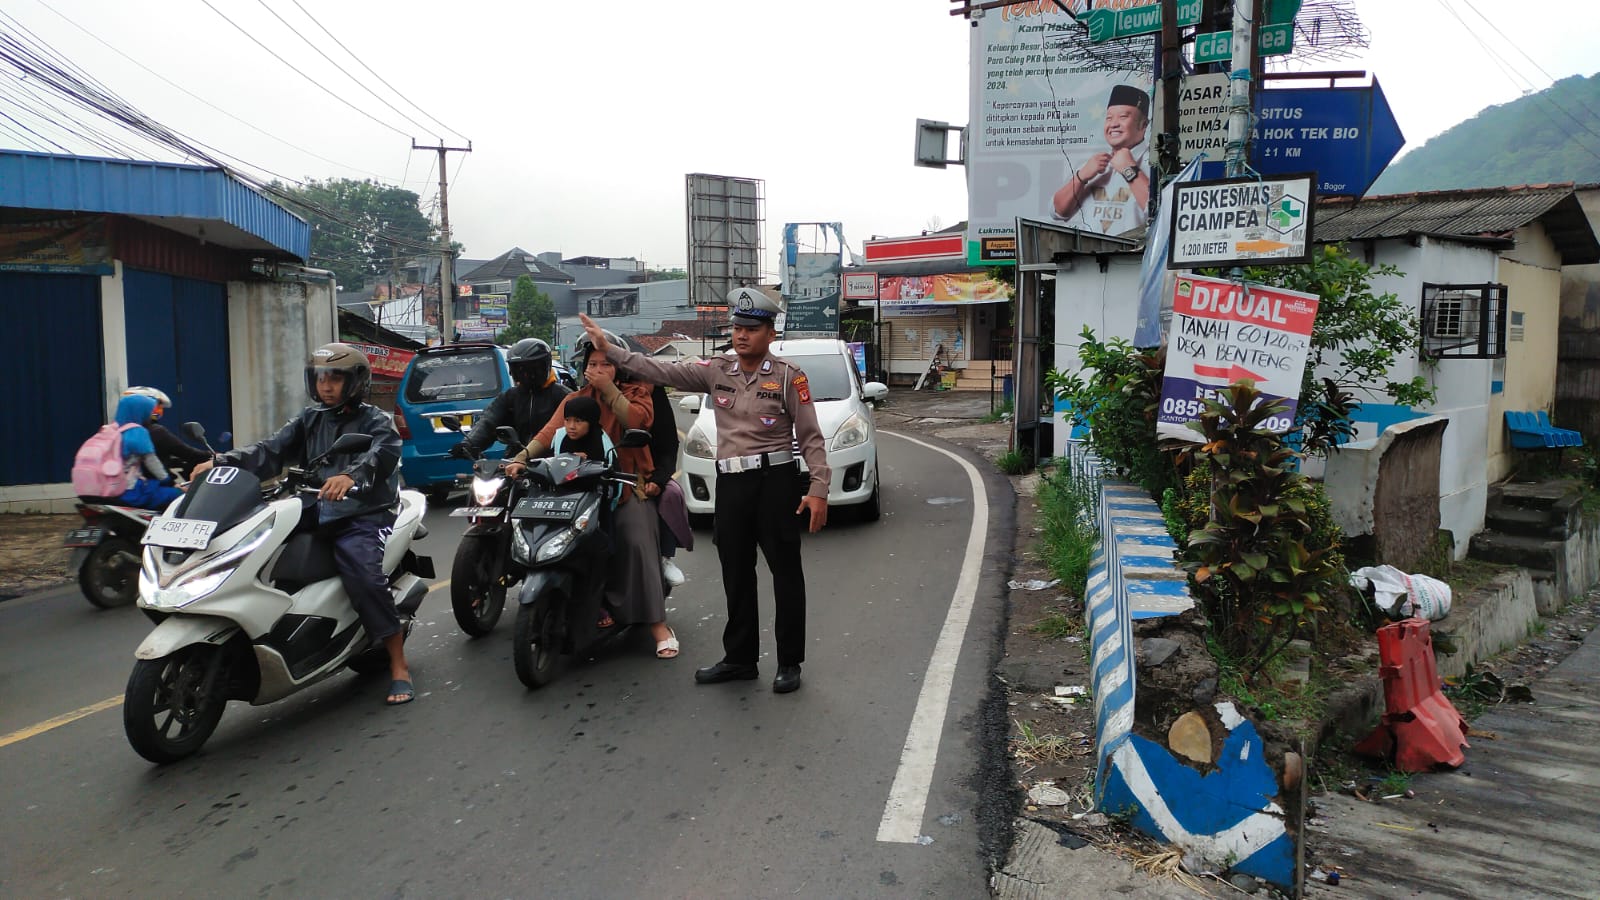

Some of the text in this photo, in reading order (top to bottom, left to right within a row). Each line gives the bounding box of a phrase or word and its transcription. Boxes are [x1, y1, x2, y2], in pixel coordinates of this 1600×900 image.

[987, 43, 1018, 54] Keluarga
[1199, 29, 1284, 57] ciaea
[987, 56, 1003, 65] Para
[1004, 56, 1024, 66] Caleg
[1025, 54, 1041, 63] PKB
[1043, 54, 1055, 62] dan
[986, 70, 1004, 79] yang
[1005, 68, 1023, 77] telah
[1055, 66, 1068, 75] dan
[986, 81, 1008, 90] 2024.
[992, 101, 1037, 110] Kepercayaan
[1038, 101, 1056, 109] yang
[1057, 99, 1076, 107] telah
[986, 111, 1080, 122] dititipkan kepada PKB akan
[1261, 107, 1303, 119] SITUS
[985, 123, 1077, 135] digunakan sebaik mungkin
[1196, 119, 1221, 132] IM3
[1264, 127, 1294, 140] HOK
[1300, 127, 1328, 139] TEK
[1333, 126, 1359, 139] BIO
[985, 137, 1005, 146] untuk
[1006, 136, 1055, 145] kemaslahatan
[1056, 135, 1088, 144] bersama
[1285, 147, 1302, 158] KM
[1323, 182, 1346, 192] Bogor
[1180, 185, 1270, 211] PUSKESMAS
[1094, 207, 1123, 220] PKB
[1178, 210, 1259, 232] CIAMPEA
[1182, 241, 1228, 256] 1.200 METER
[1191, 286, 1287, 324] DIJUAL
[1179, 314, 1230, 341] TANAH
[1177, 336, 1294, 372] DESA BENTENG
[757, 391, 781, 401] POLRI
[519, 500, 527, 508] F
[151, 519, 210, 536] F 4587 FFL
